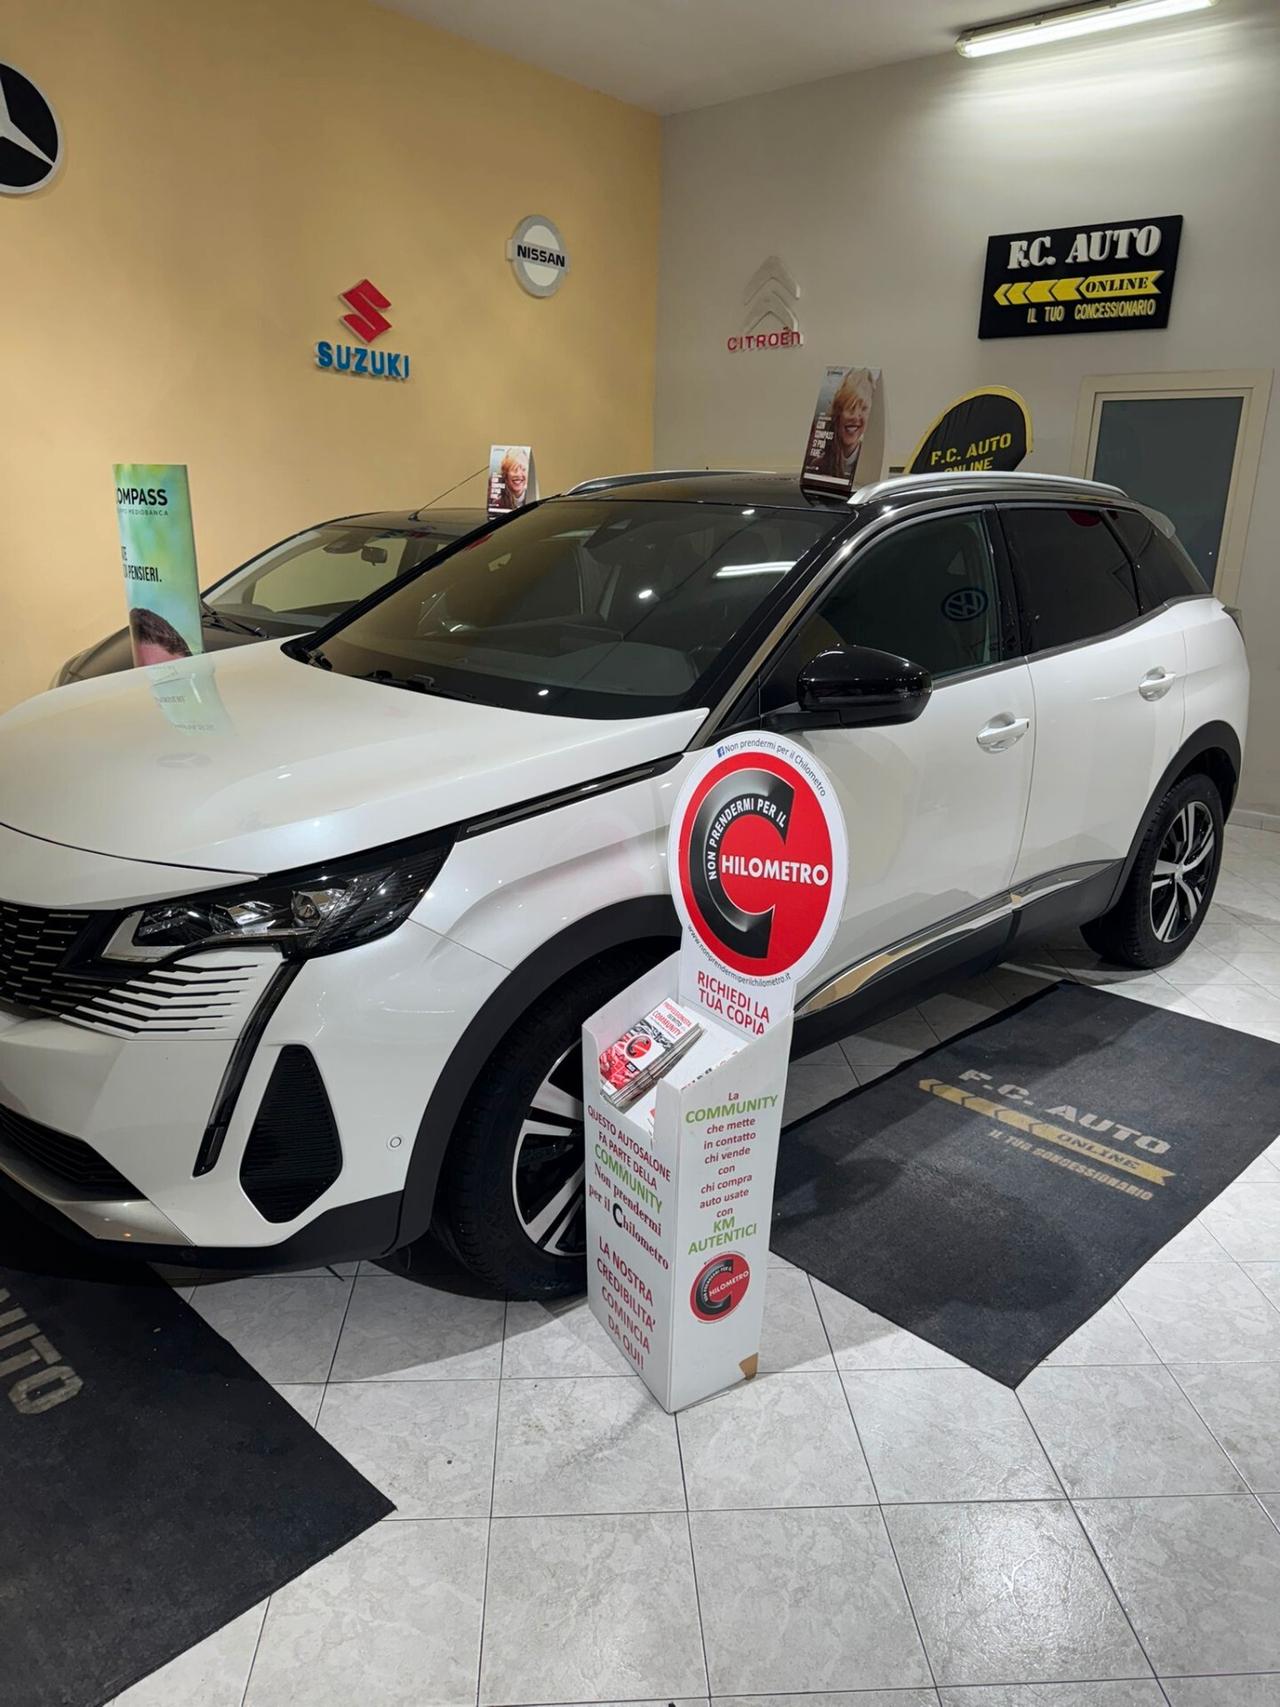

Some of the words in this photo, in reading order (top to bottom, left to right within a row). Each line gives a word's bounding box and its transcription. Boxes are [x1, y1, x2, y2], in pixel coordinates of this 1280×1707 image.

[517, 244, 565, 268] NISSAN
[1007, 235, 1057, 269] F.C.
[1065, 225, 1162, 264] AUTO
[1085, 276, 1149, 293] ONLINE
[1027, 307, 1037, 323] IL
[1044, 305, 1065, 322] TUO
[1074, 299, 1156, 321] CONCESSIONARIO
[314, 340, 411, 379] SUZUKI
[930, 448, 961, 465] F.C.
[966, 432, 1012, 458] AUTO
[115, 487, 168, 506] OMPASS
[725, 743, 739, 754] Non
[740, 738, 776, 750] prendermi
[776, 745, 789, 755] per
[790, 750, 796, 760] il
[794, 754, 826, 797] Chilometro
[709, 797, 754, 849] PRENDERMI
[757, 798, 777, 818] PER
[776, 811, 788, 829] IL
[708, 849, 717, 881] NON
[697, 971, 751, 1011] RICHIEDI
[754, 1001, 770, 1023] LA
[699, 988, 723, 1014] TUA
[726, 1005, 765, 1035] COPIA
[685, 1095, 779, 1123] COMMUNITY
[728, 1092, 739, 1101] La
[703, 1140, 714, 1150] in
[716, 1131, 757, 1148] contatto
[706, 1121, 724, 1135] che
[726, 1117, 756, 1131] mette
[1045, 1104, 1172, 1154] AUTO
[587, 1104, 617, 1136] QUESTO
[617, 1130, 672, 1182] AUTOSALONE
[704, 1152, 719, 1165] chi
[721, 1146, 751, 1160] vende
[1056, 1133, 1141, 1170] ONLINE
[599, 1130, 608, 1145] FA
[609, 1139, 632, 1168] PARTE
[633, 1160, 658, 1190] DELLA
[718, 1164, 735, 1176] con
[988, 1128, 1004, 1141] IL
[1003, 1135, 1033, 1152] TUO
[1032, 1148, 1154, 1201] CONCESSIONARIO
[594, 1143, 663, 1214] COMMUNITY
[700, 1181, 715, 1194] chi
[717, 1174, 753, 1190] compra
[594, 1161, 611, 1189] Non
[613, 1184, 662, 1237] prendermi
[699, 1196, 722, 1209] auto
[724, 1188, 750, 1202] usate
[716, 1206, 734, 1218] con
[588, 1184, 603, 1202] per
[604, 1196, 611, 1212] il
[612, 1202, 669, 1270] Chilometro
[687, 1223, 758, 1255] AUTENTICI
[713, 1215, 736, 1233] KM
[599, 1236, 611, 1260] LA
[612, 1250, 654, 1307] NOSTRA
[596, 1257, 656, 1332] CREDIBILITA'
[601, 1285, 651, 1354] COMINCIA
[608, 1313, 621, 1340] DA
[0, 1287, 84, 1415] UTO
